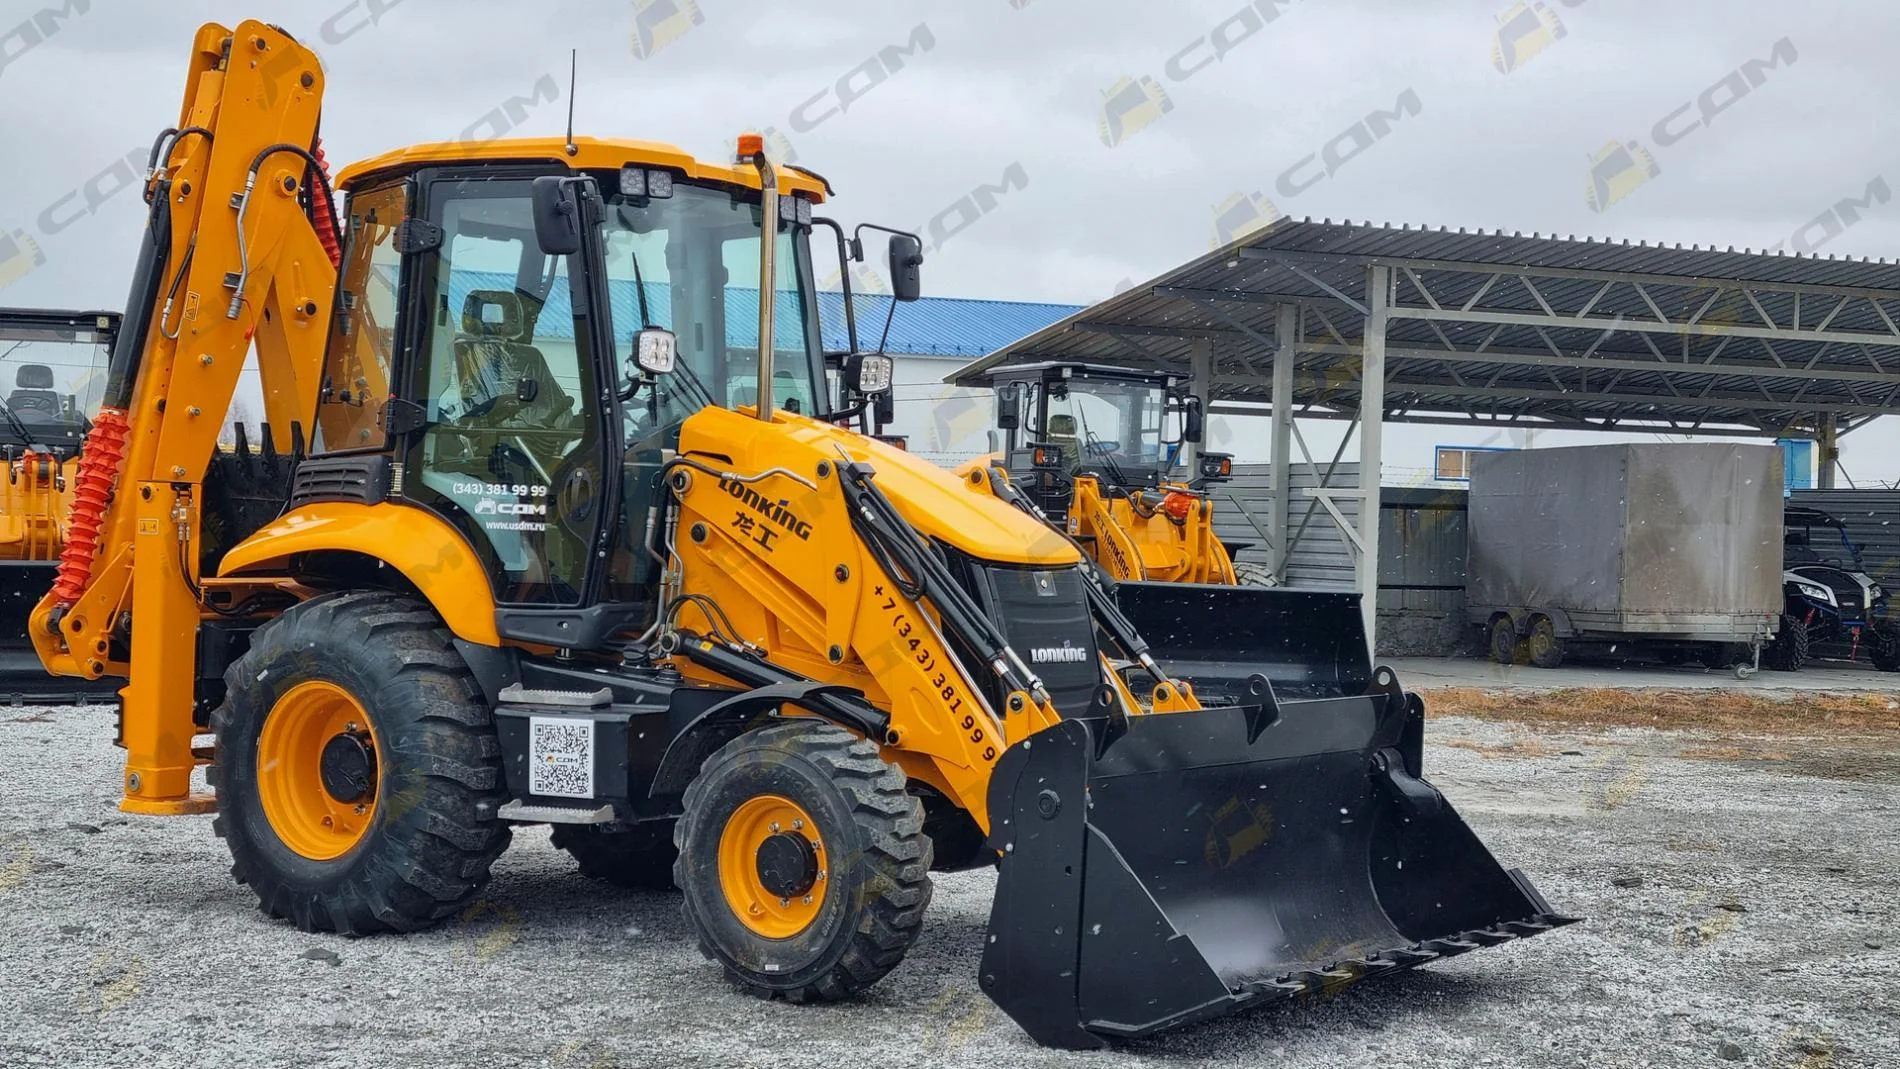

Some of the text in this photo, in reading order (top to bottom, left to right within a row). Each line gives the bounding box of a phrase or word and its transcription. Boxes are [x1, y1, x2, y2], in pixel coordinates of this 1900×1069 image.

[453, 483, 547, 497] (343) 381 99 99
[485, 521, 545, 531] www.usdm.ru
